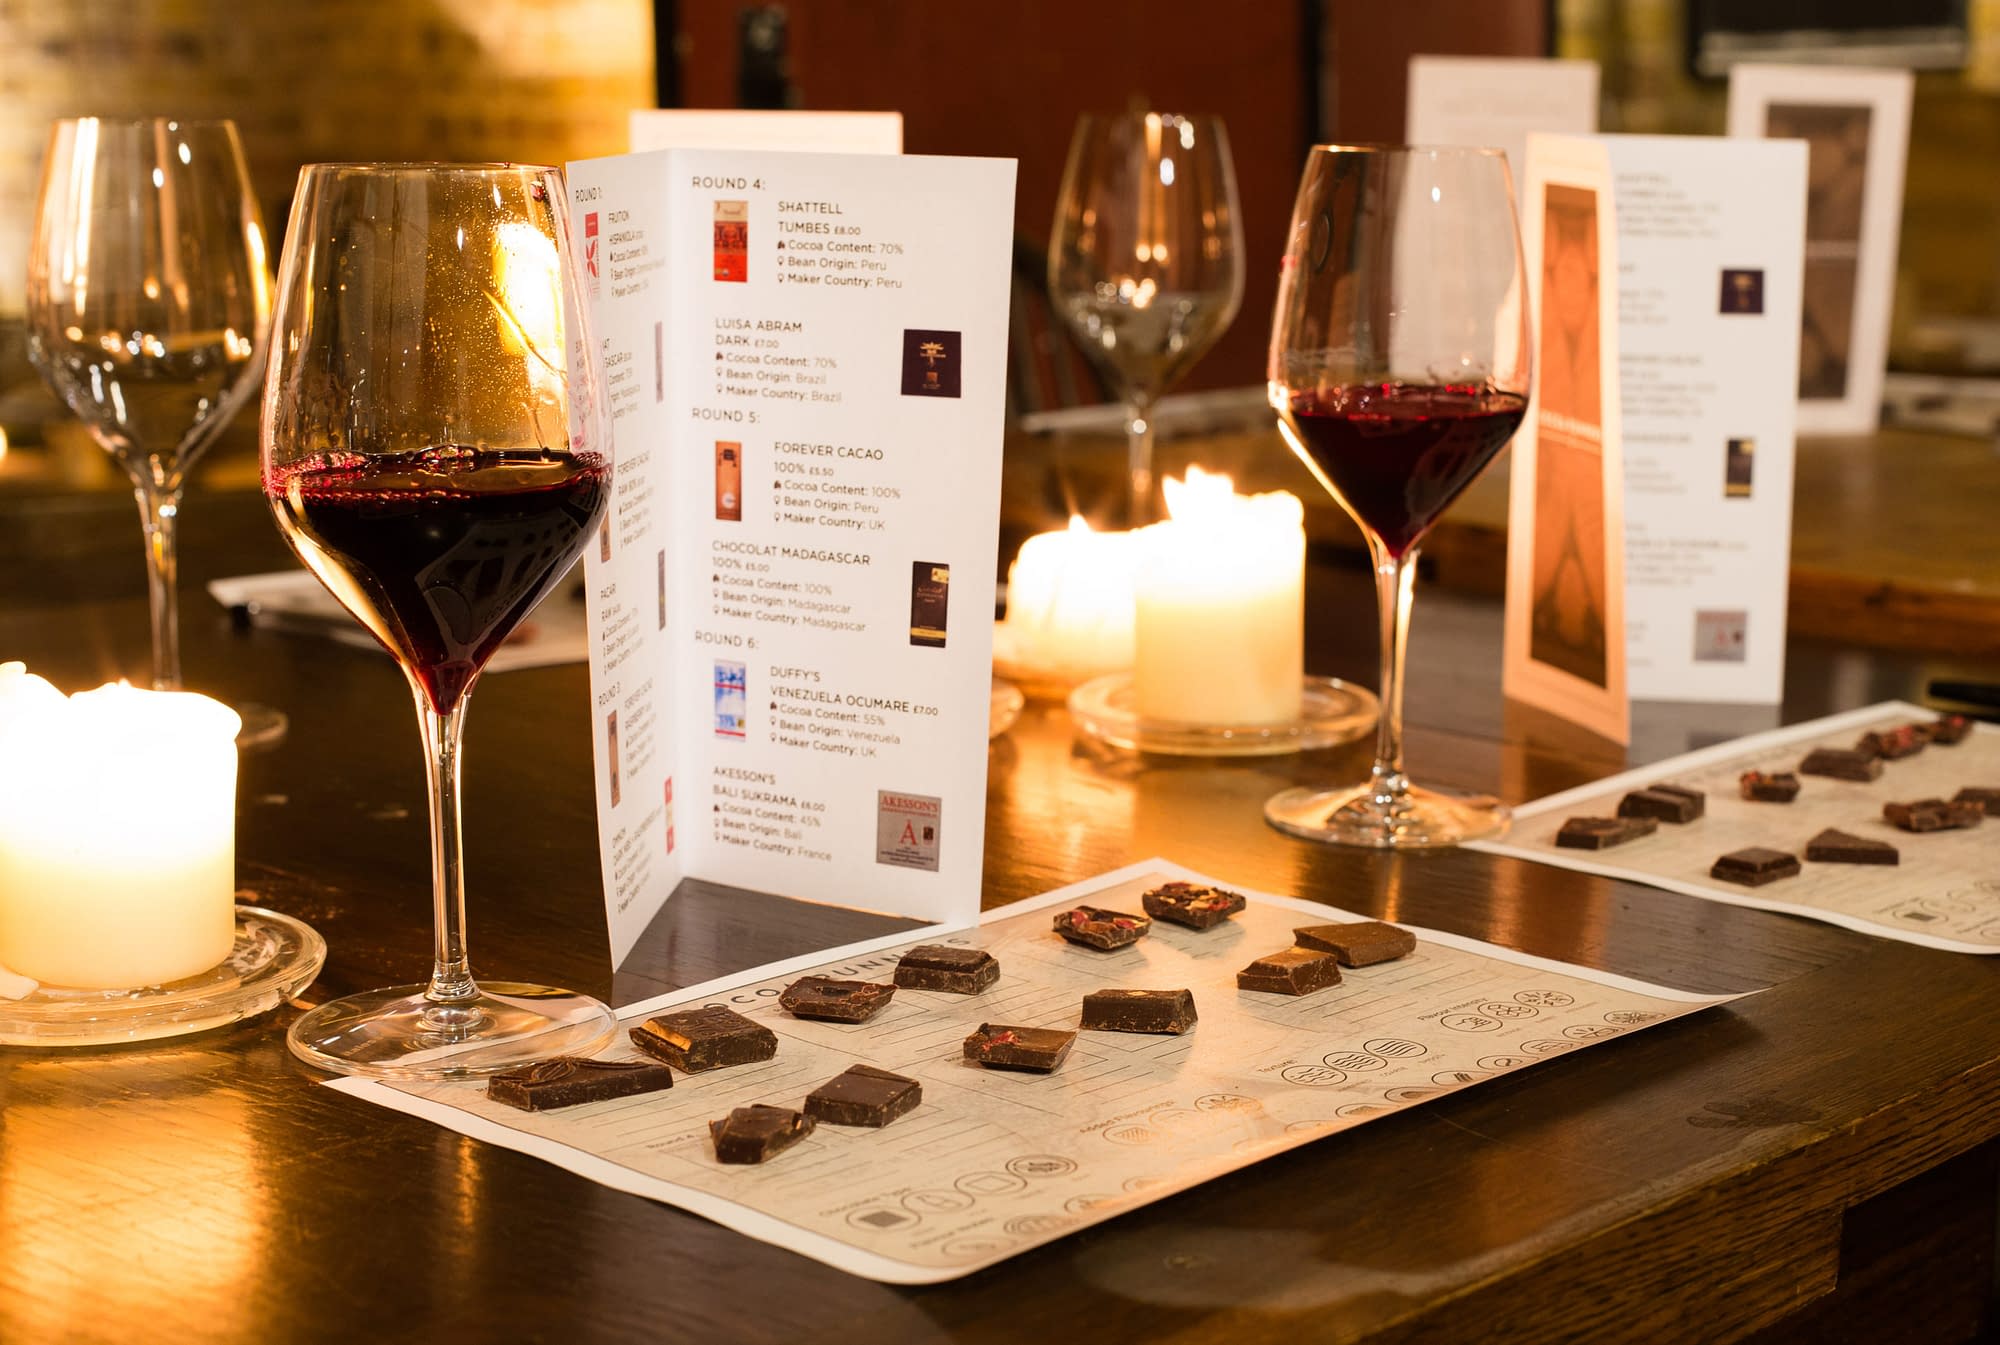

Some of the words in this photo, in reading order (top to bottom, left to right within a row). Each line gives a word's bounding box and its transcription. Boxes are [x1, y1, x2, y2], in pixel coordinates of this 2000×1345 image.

[692, 176, 747, 190] ROUND
[753, 179, 765, 189] 4:
[576, 187, 597, 202] ROUND
[778, 201, 843, 215] SHATTELL
[778, 221, 830, 234] TUMBES
[788, 239, 824, 251] Cocoa
[827, 241, 876, 253] Content:
[878, 243, 904, 255] 70%
[788, 256, 815, 267] Bean
[818, 257, 857, 271] Origin:
[861, 259, 887, 272] Peru
[787, 273, 821, 284] Maker
[824, 274, 873, 288] Country:
[876, 277, 902, 288] Peru
[715, 318, 752, 330] LUISA
[756, 320, 802, 332] ABRAM
[716, 334, 750, 346] DARK
[725, 352, 761, 364] Cocoa
[763, 354, 810, 368] Content:
[813, 357, 837, 368] 70%
[726, 368, 754, 380] Bean
[795, 372, 826, 384] Brazil
[726, 385, 758, 396] Maker
[761, 387, 808, 402] Country:
[811, 390, 842, 402] Brazil
[692, 408, 743, 422] ROUND
[749, 411, 760, 424] 5:
[774, 442, 834, 456] FOREVER
[837, 447, 883, 460] CACAO
[774, 461, 806, 474] 100%
[784, 479, 818, 493] Cocoa
[821, 482, 868, 496] Content:
[872, 486, 901, 499] 100%
[784, 496, 811, 507] Bean
[814, 498, 851, 512] Origin:
[854, 501, 879, 514] Peru
[784, 513, 816, 524] Maker
[819, 515, 865, 530] Country:
[869, 520, 885, 531] UK
[712, 540, 778, 558] CHOCOLAT
[782, 547, 871, 566] MADAGASCAR
[712, 556, 742, 570] 100%
[722, 574, 754, 587] Cocoa
[757, 578, 801, 592] Content:
[804, 583, 832, 596] 100%
[722, 590, 748, 602] Bean
[750, 593, 785, 608] Origin:
[788, 598, 852, 614] Madagascar
[723, 608, 752, 619] Maker
[755, 608, 801, 626] Country:
[802, 614, 866, 632] Madagascar
[695, 630, 743, 647] ROUND
[747, 637, 758, 648] 6:
[770, 666, 820, 682] DUFFY'S
[599, 685, 615, 705] ROUND
[770, 686, 842, 706] VENEZUELA
[846, 695, 909, 712] OCUMARE
[913, 705, 939, 716] £7.00
[779, 703, 812, 717] Cocoa
[814, 708, 860, 725] Content:
[864, 713, 886, 727] 55%
[780, 719, 805, 732] Bean
[808, 721, 844, 737] Origin:
[845, 726, 900, 746] Venezuela
[779, 736, 809, 748] Maker
[813, 740, 857, 757] Country:
[860, 746, 876, 758] UK
[713, 766, 776, 786] AKESSON'S
[713, 784, 738, 798] BALI
[741, 789, 797, 808] SUKRAMA
[881, 796, 938, 812] AKESSON'S
[721, 802, 752, 818] Cocoa
[754, 807, 797, 825] Content:
[800, 816, 821, 827] 45%
[722, 817, 746, 830] Bean
[748, 822, 780, 837] Origin:
[722, 834, 750, 846] Maker
[753, 837, 796, 856] Country:
[798, 846, 832, 862] France
